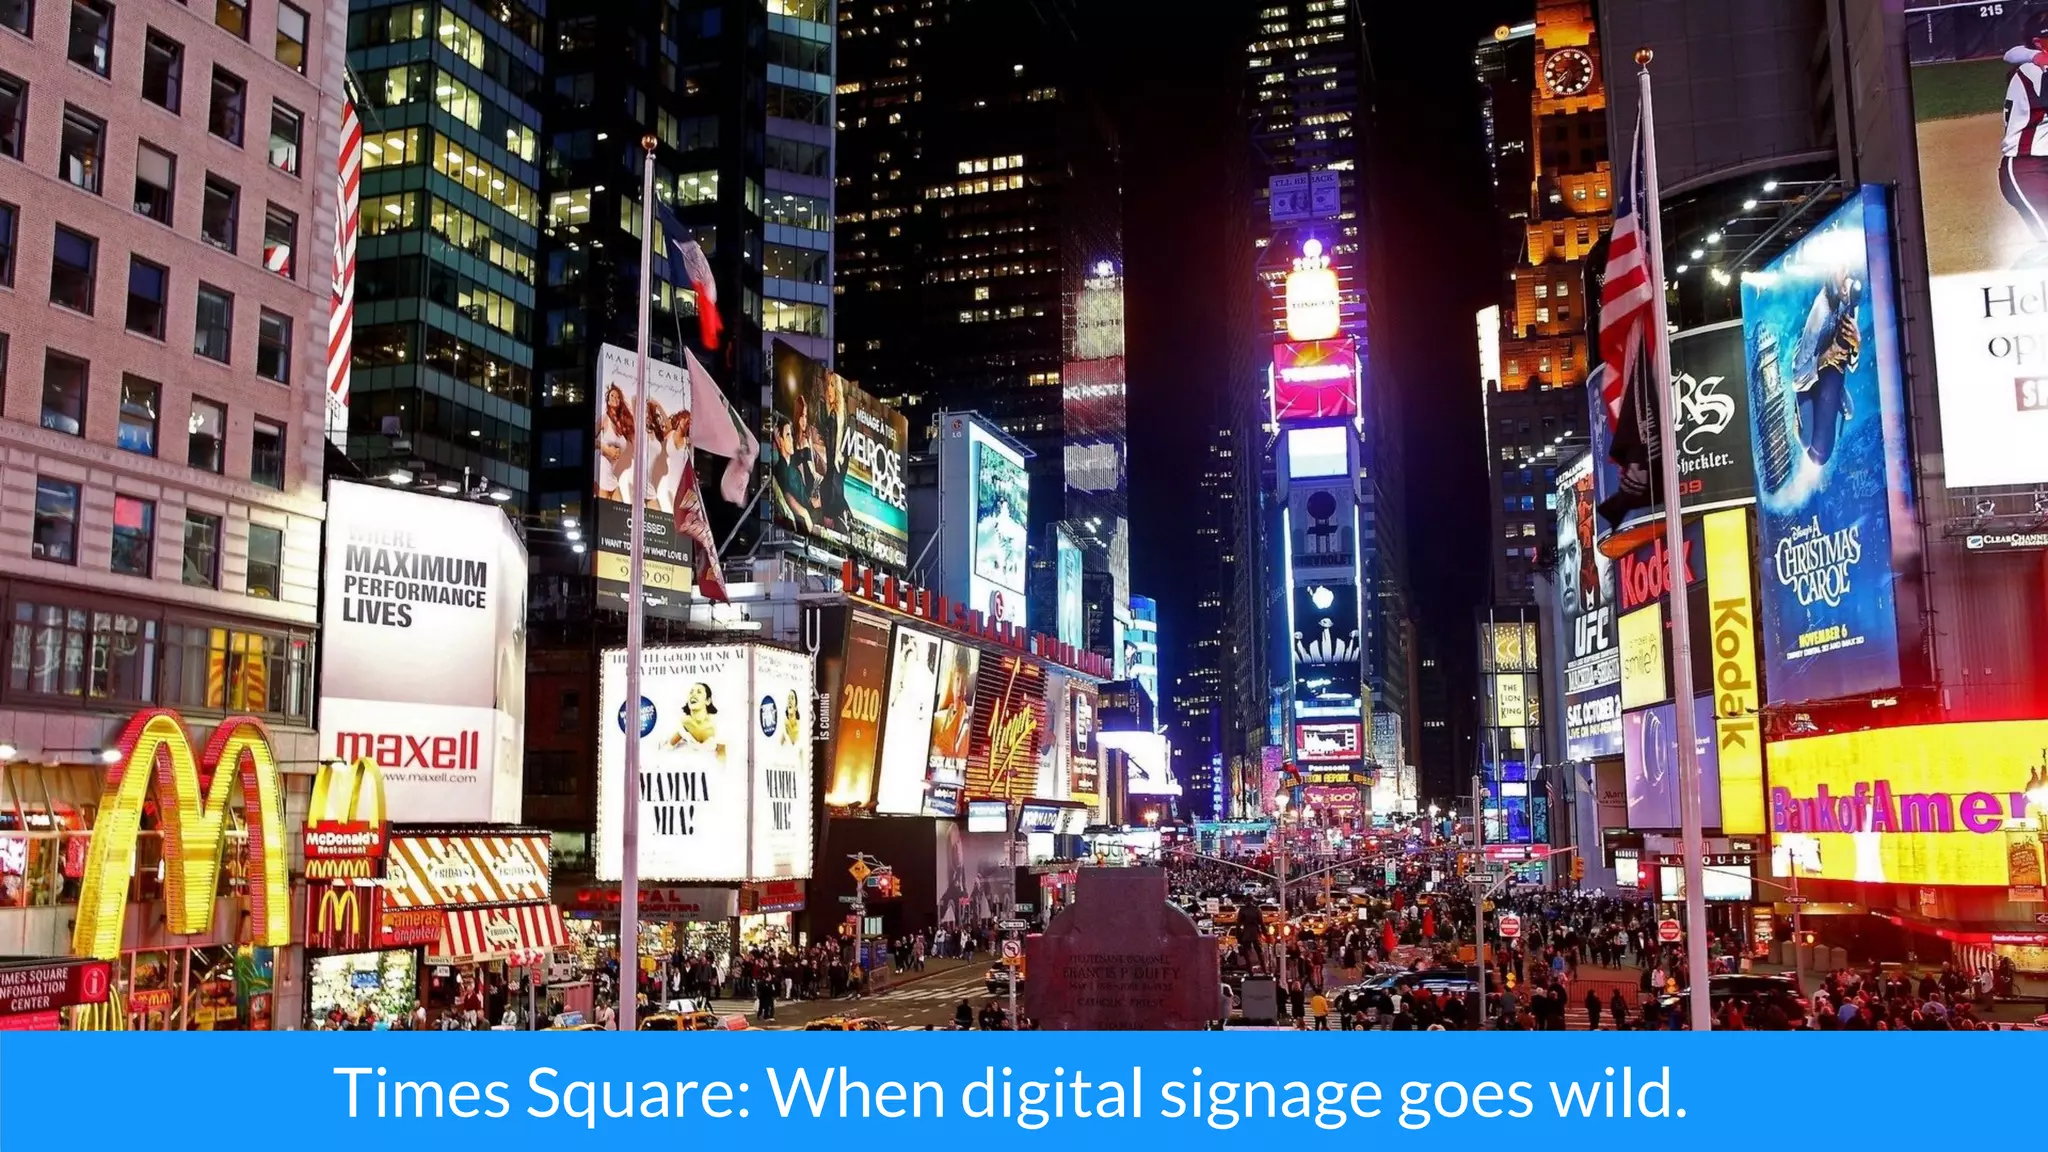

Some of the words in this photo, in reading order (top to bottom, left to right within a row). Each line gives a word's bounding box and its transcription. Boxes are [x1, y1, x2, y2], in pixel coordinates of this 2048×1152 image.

[1980, 4, 2003, 17] 215
[1274, 178, 1292, 188] I'LL
[841, 426, 902, 483] MELROSE
[871, 471, 908, 511] PLACE
[349, 525, 417, 549] WHERE
[605, 538, 623, 549] WANT
[345, 544, 487, 588] MAXIMUM
[651, 547, 667, 558] WHAT
[667, 550, 682, 561] LOVE
[1774, 525, 1861, 592] CHRISTMAS
[1620, 538, 1695, 609] Kodak
[1797, 560, 1850, 608] CAROL
[344, 575, 487, 609] PERFORMANCE
[343, 597, 412, 628] LIVES
[1575, 606, 1610, 658] UFC
[1799, 627, 1840, 648] NOVEMBER
[1841, 624, 1848, 638] 6
[1713, 597, 1755, 750] Kodak
[820, 693, 830, 729] COMING
[841, 684, 880, 723] 2010
[1501, 693, 1520, 705] LION
[1501, 707, 1522, 719] KING
[1583, 696, 1614, 724] OCTOBER
[336, 730, 479, 770] maxell
[381, 772, 477, 784] ww.maxell.com
[640, 772, 709, 801] MAMMA
[766, 769, 797, 800] MAMMA
[653, 805, 694, 835] MIA!
[772, 801, 792, 830] MIA!
[306, 831, 380, 846] McDonald's
[318, 845, 366, 854] Restaurant
[1660, 855, 1751, 865] MAQUIS
[29, 967, 69, 983] SQUARE
[1063, 967, 1115, 979] FRANCIS
[1134, 967, 1181, 979] DUFFY
[0, 981, 66, 999] NFORMATION
[11, 995, 51, 1012] CENTER
